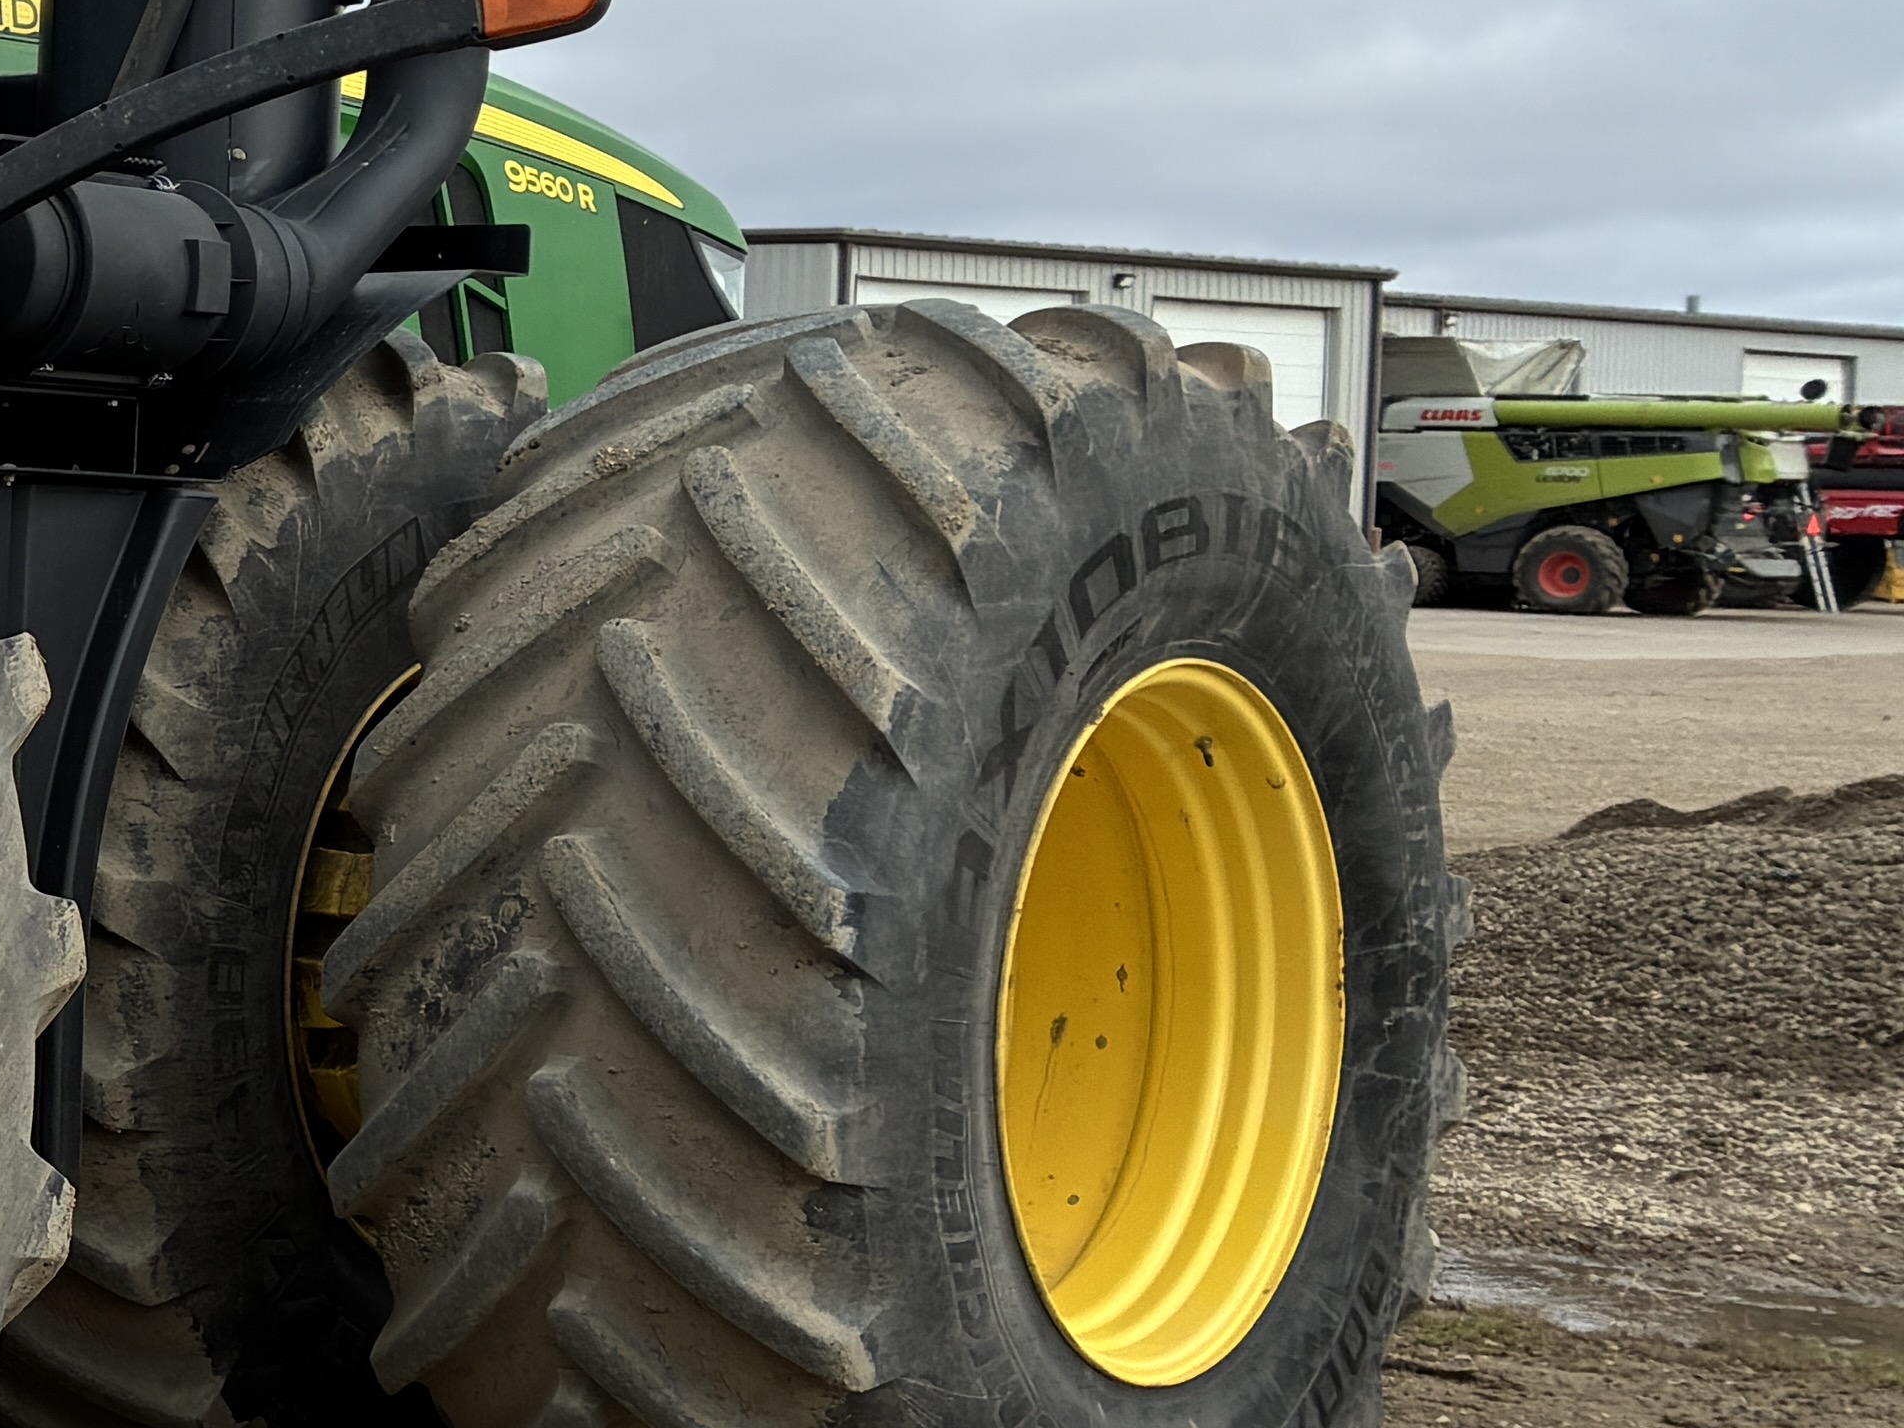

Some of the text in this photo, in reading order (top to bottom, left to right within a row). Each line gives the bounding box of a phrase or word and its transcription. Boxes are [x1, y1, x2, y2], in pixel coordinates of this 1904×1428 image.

[503, 158, 599, 214] 9560 R
[1420, 408, 1483, 422] CLAAS
